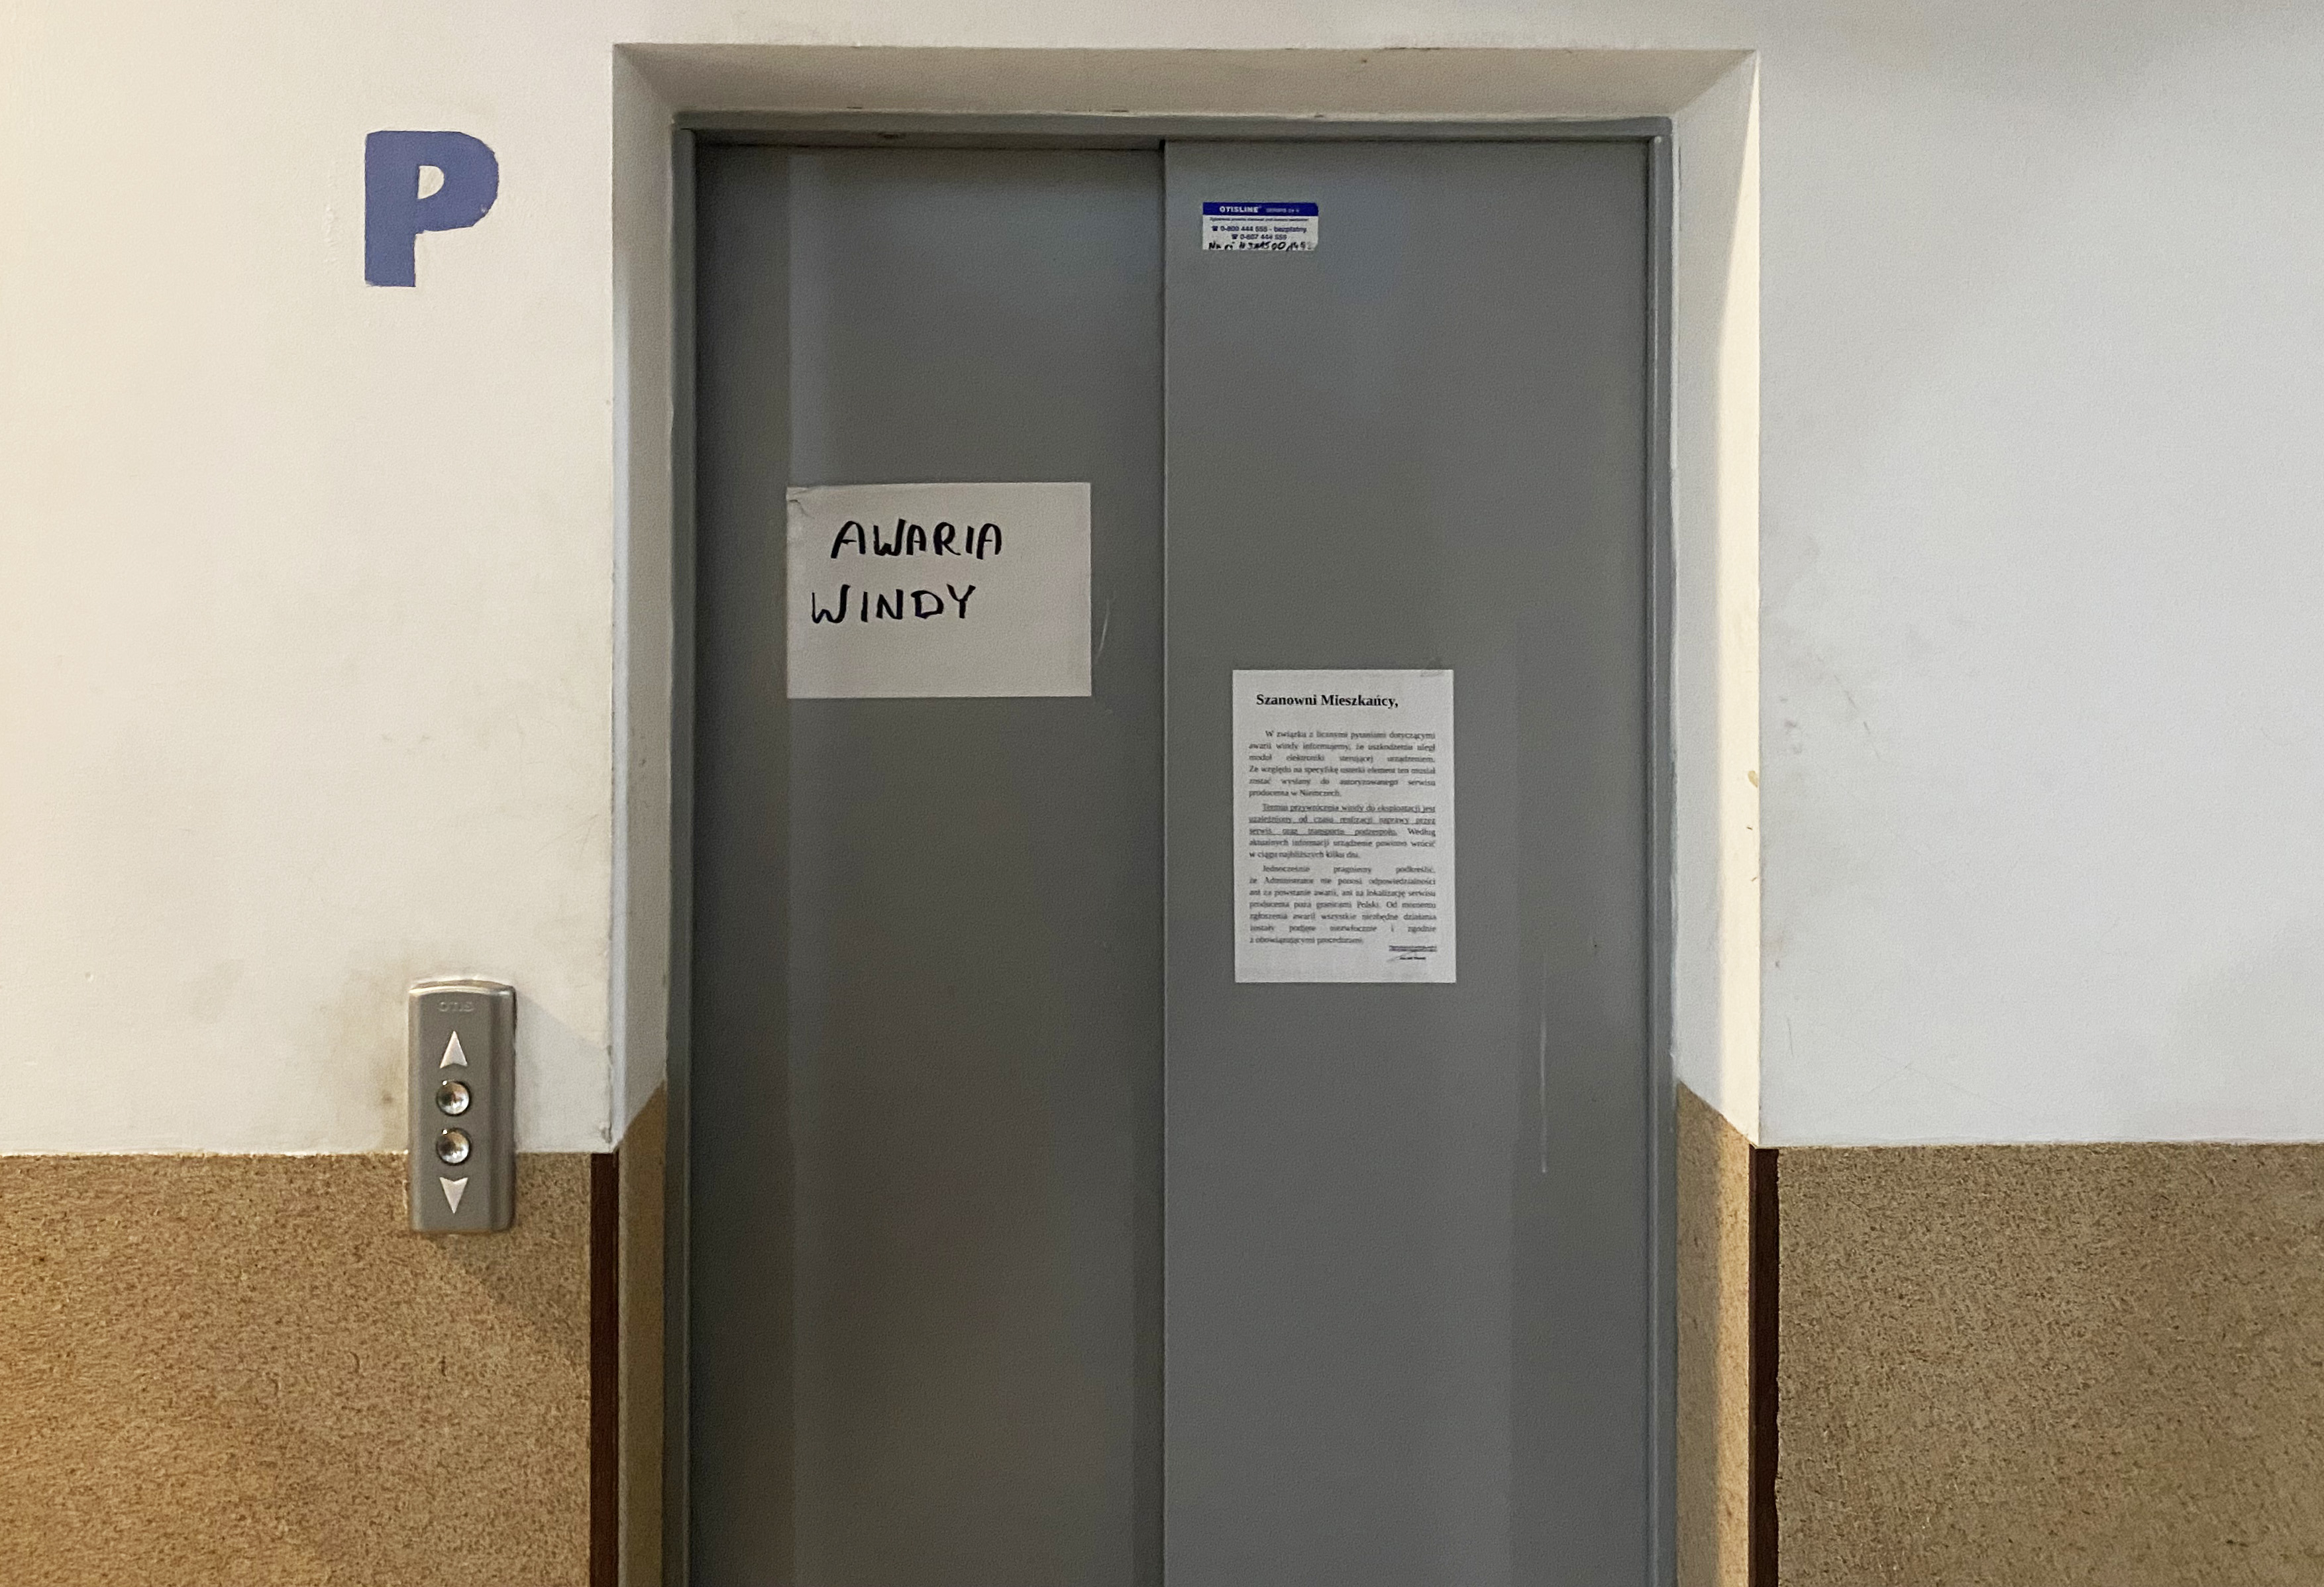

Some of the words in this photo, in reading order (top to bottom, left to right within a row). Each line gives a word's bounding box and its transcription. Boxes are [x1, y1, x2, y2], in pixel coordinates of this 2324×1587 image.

[365, 130, 499, 287] P
[830, 518, 1003, 559] AWARIA
[812, 583, 976, 624] WINDY
[1256, 694, 1318, 705] Szanowni
[1320, 695, 1398, 709] Mieszkańcy,
